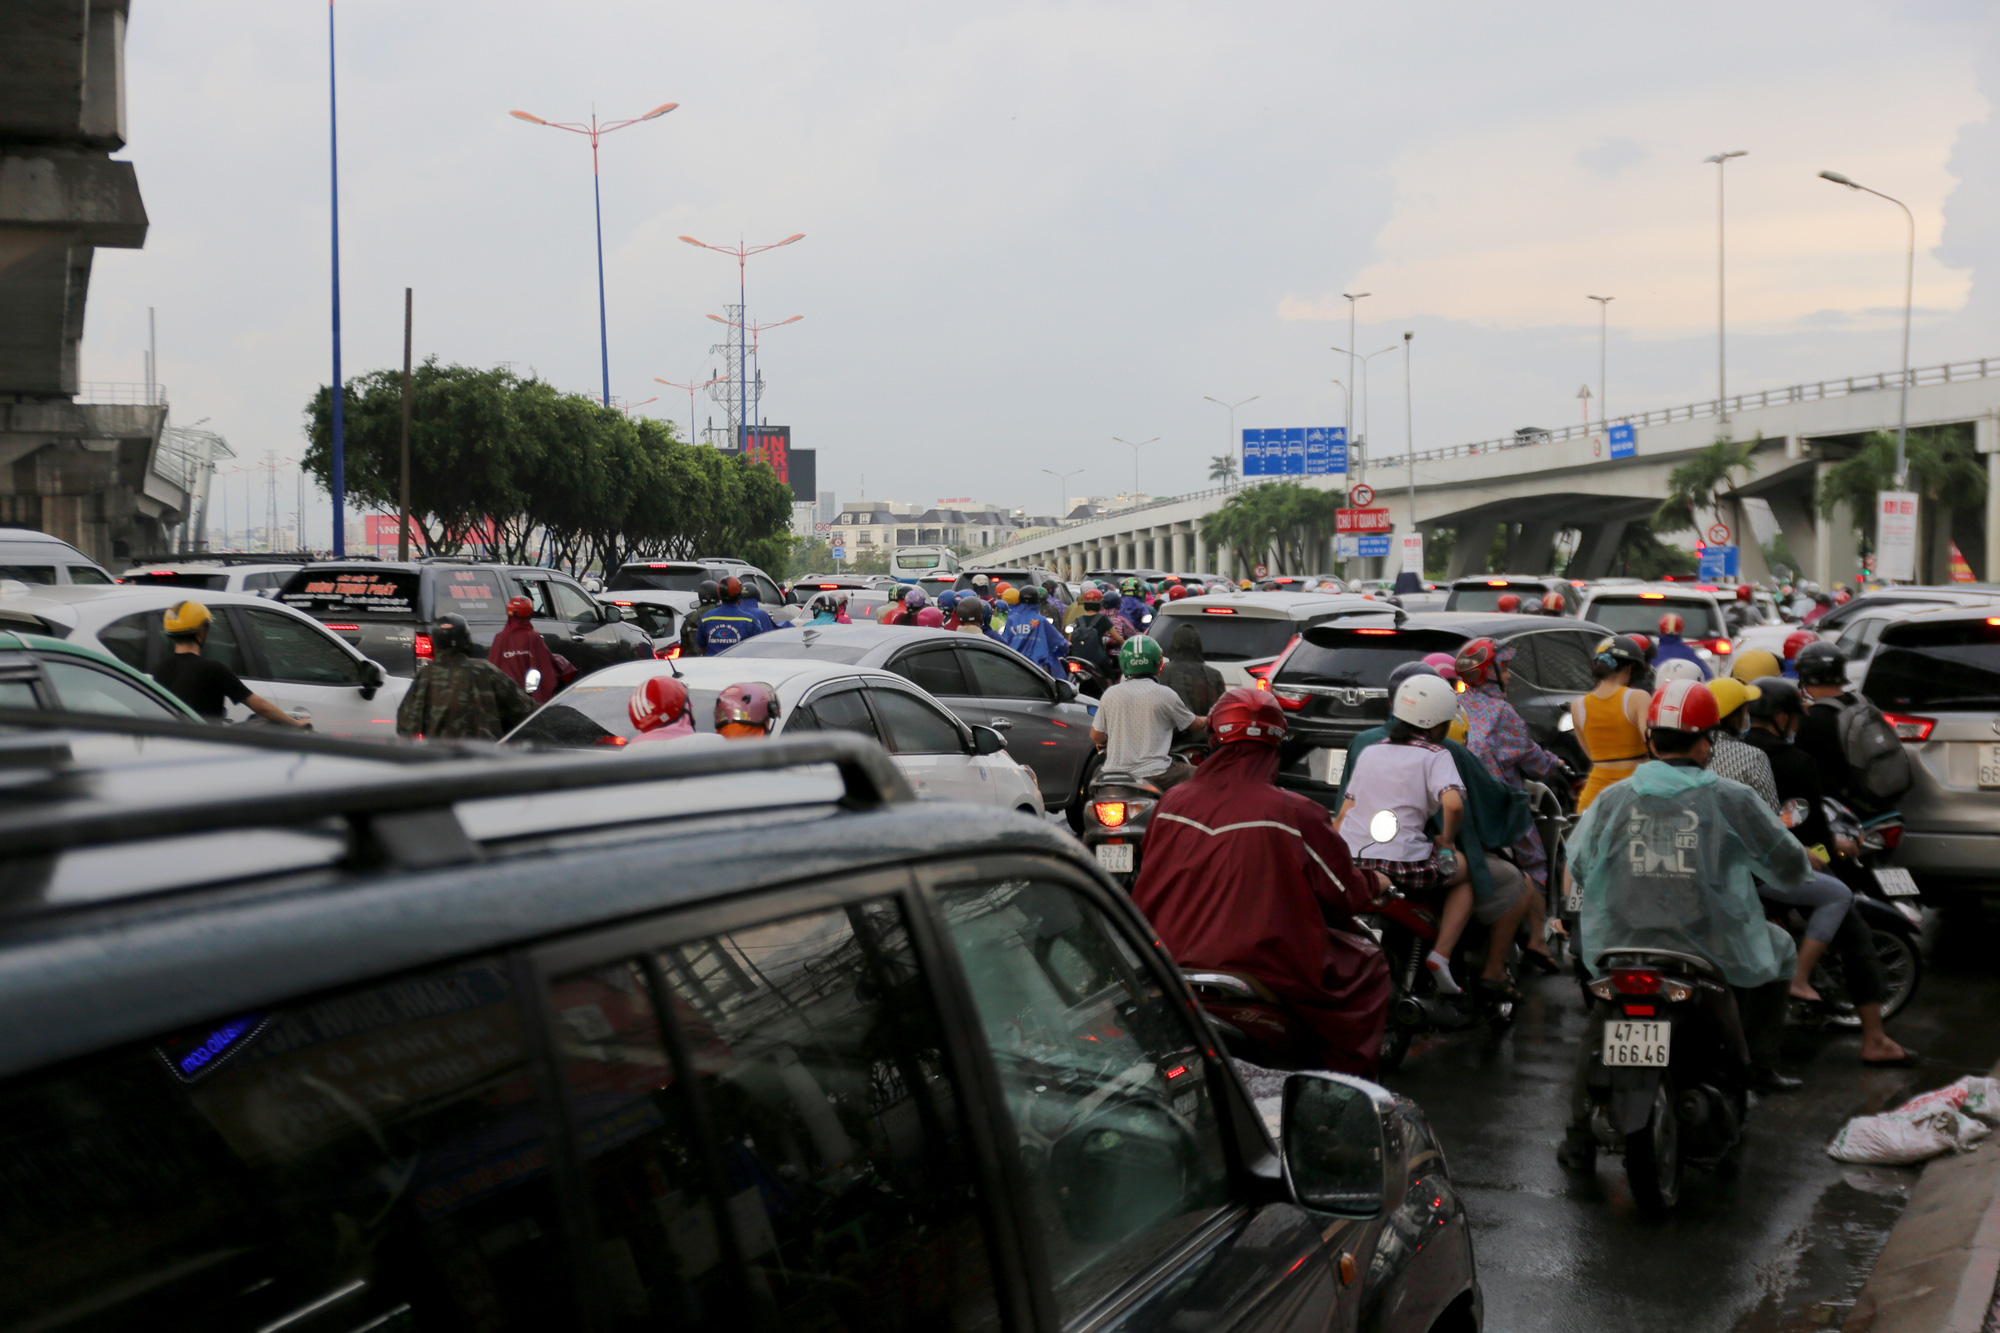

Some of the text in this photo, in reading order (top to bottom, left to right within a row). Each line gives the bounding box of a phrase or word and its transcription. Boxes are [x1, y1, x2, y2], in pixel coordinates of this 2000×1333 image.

[1338, 510, 1390, 529] CHÚ Ý QUAN SÁT
[1130, 657, 1149, 666] Grab
[1615, 1023, 1659, 1041] 47-T1
[1608, 1044, 1666, 1063] 166.46
